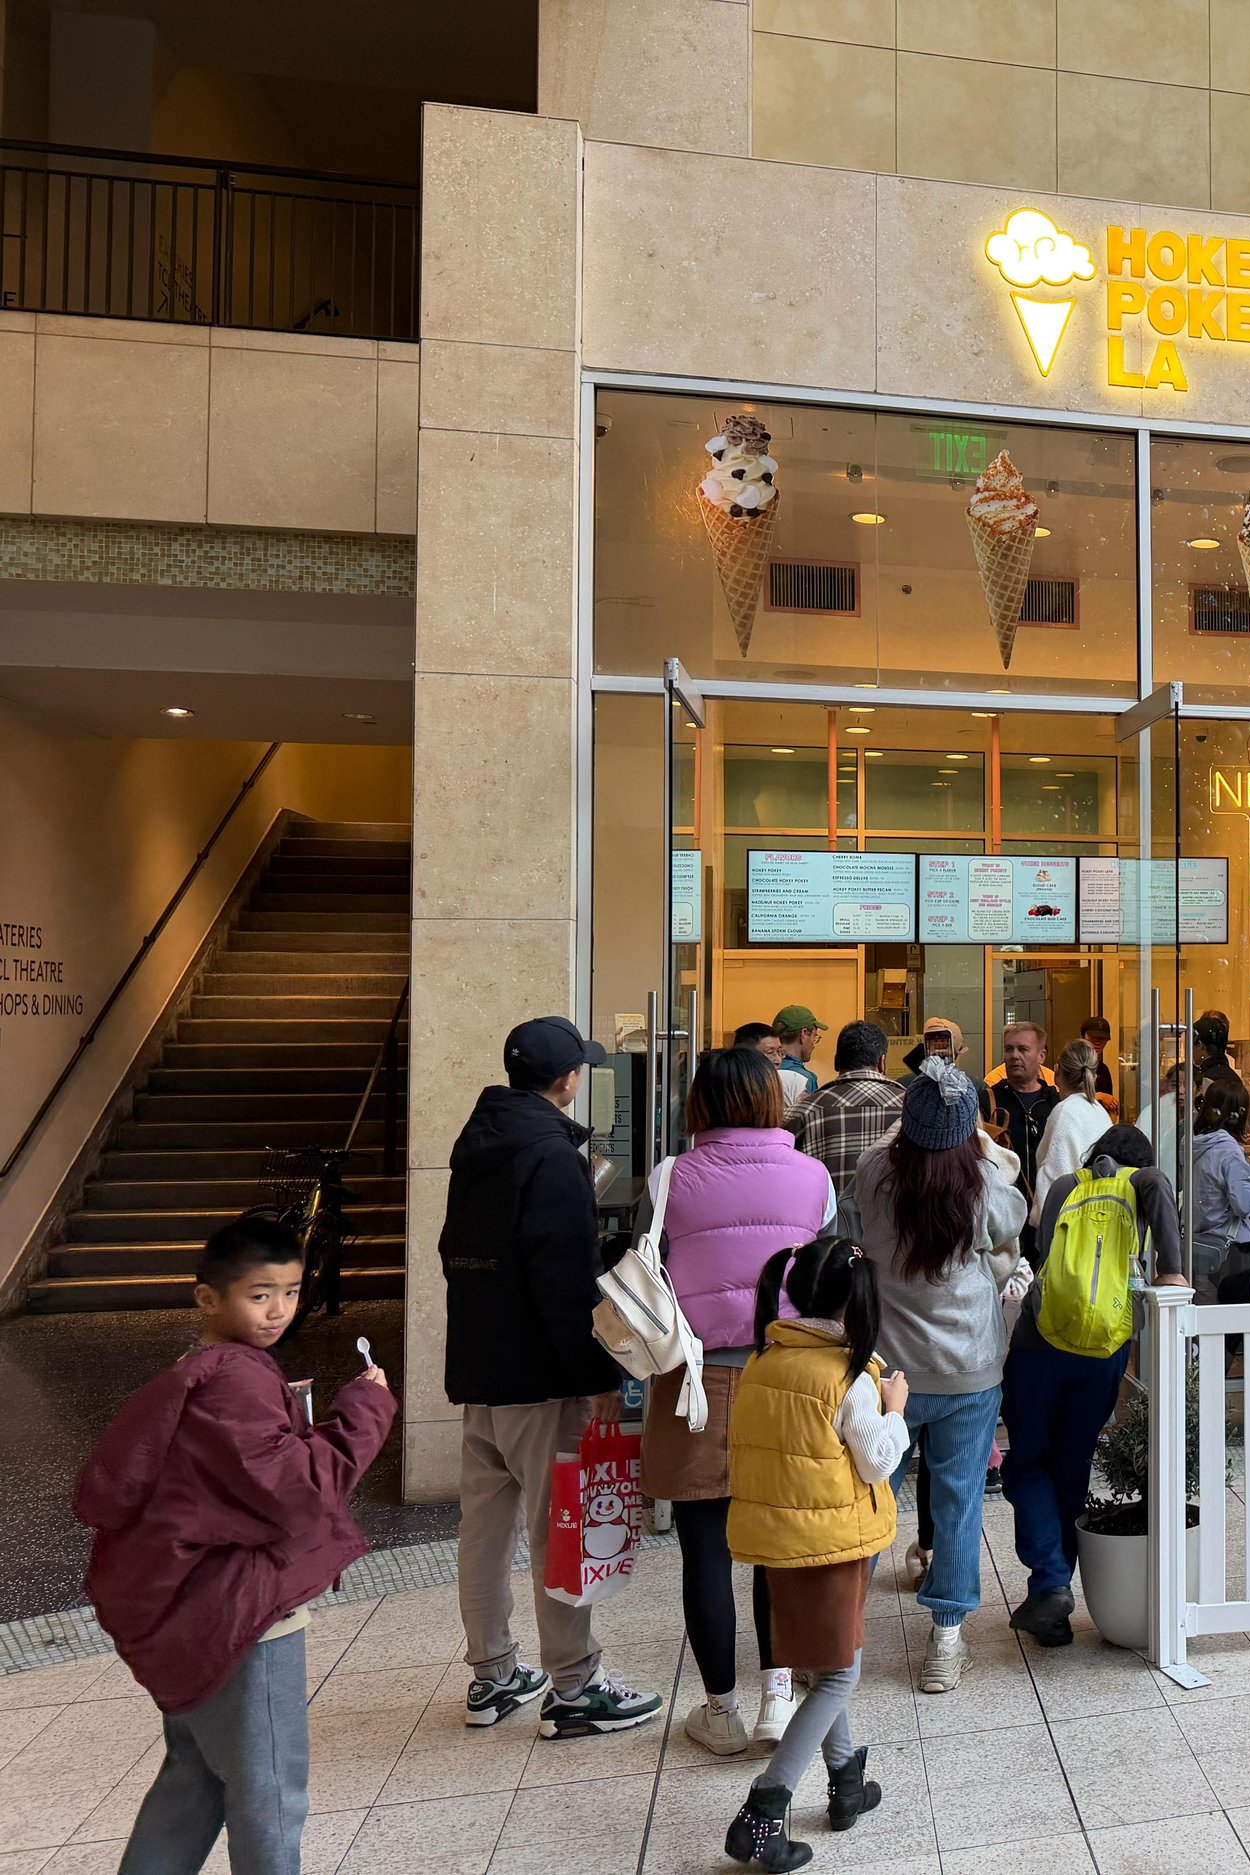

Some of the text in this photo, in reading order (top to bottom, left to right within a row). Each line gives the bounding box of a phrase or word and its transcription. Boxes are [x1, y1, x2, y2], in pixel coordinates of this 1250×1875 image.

[1107, 335, 1188, 392] LA
[13, 959, 63, 983] THEATRE
[31, 994, 40, 1016] &
[43, 994, 83, 1016] DINING
